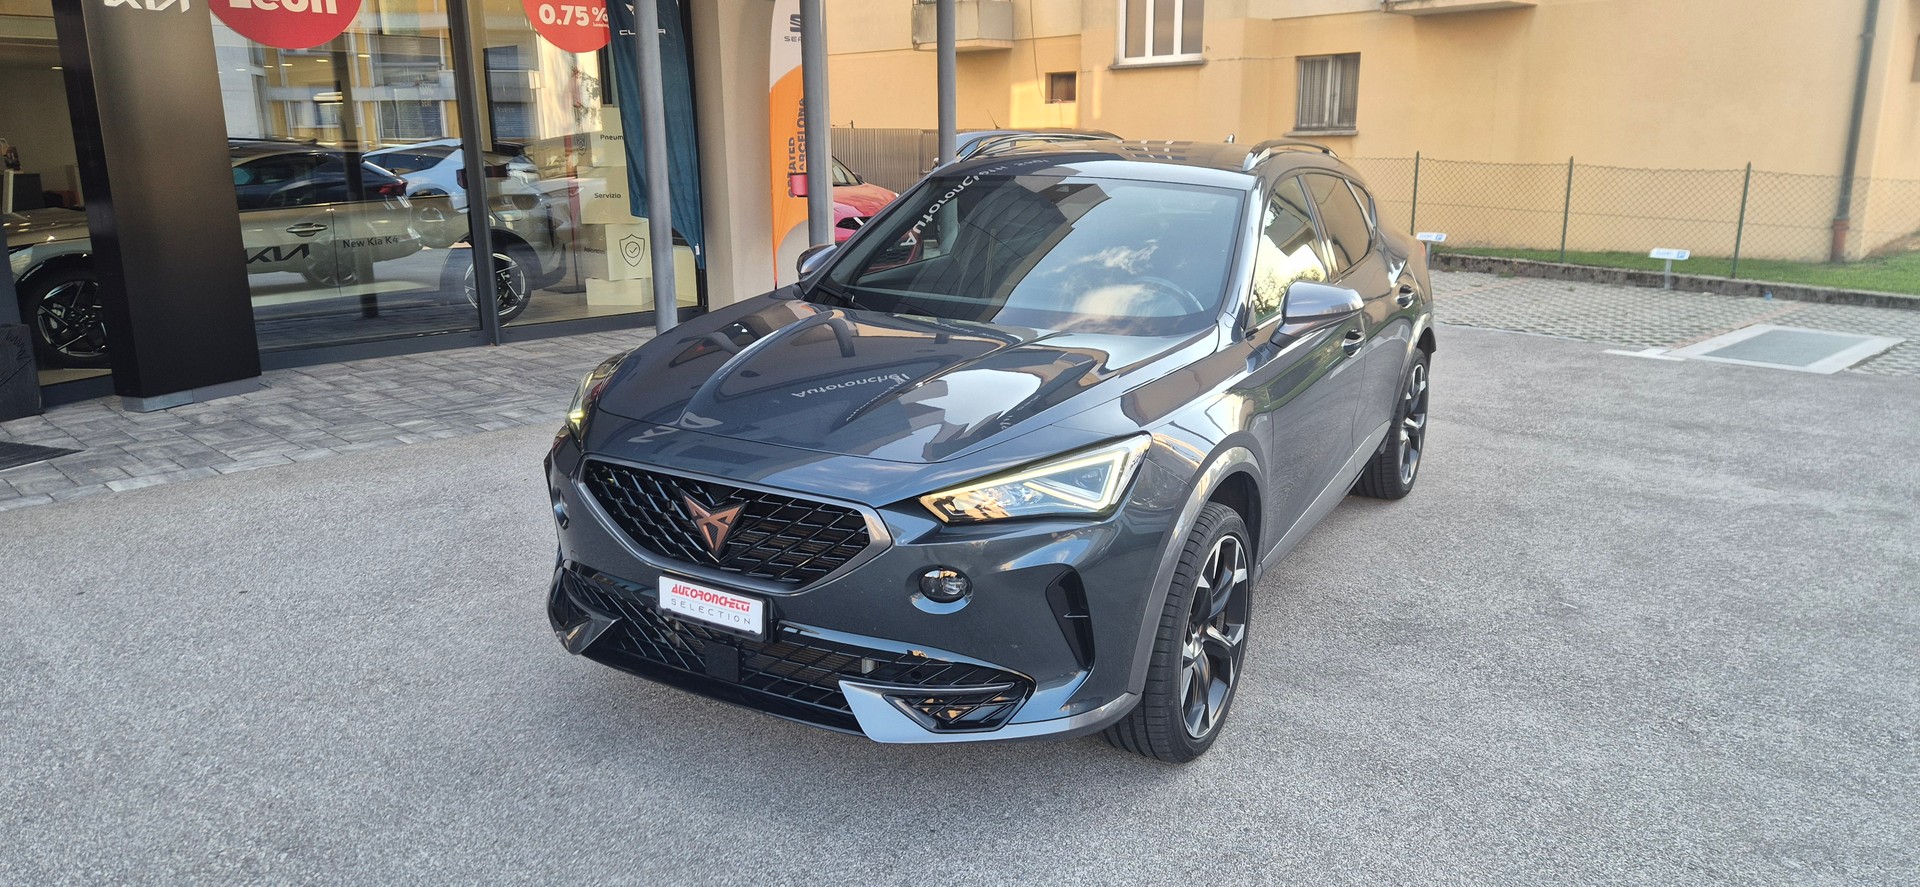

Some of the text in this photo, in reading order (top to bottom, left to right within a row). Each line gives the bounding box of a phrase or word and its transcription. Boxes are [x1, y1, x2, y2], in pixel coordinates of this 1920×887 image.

[538, 3, 609, 26] 0.75 %
[343, 239, 365, 249] New
[367, 237, 383, 246] Kia
[671, 583, 751, 613] AUTORONCHETTI
[671, 598, 751, 625] SELECTION
